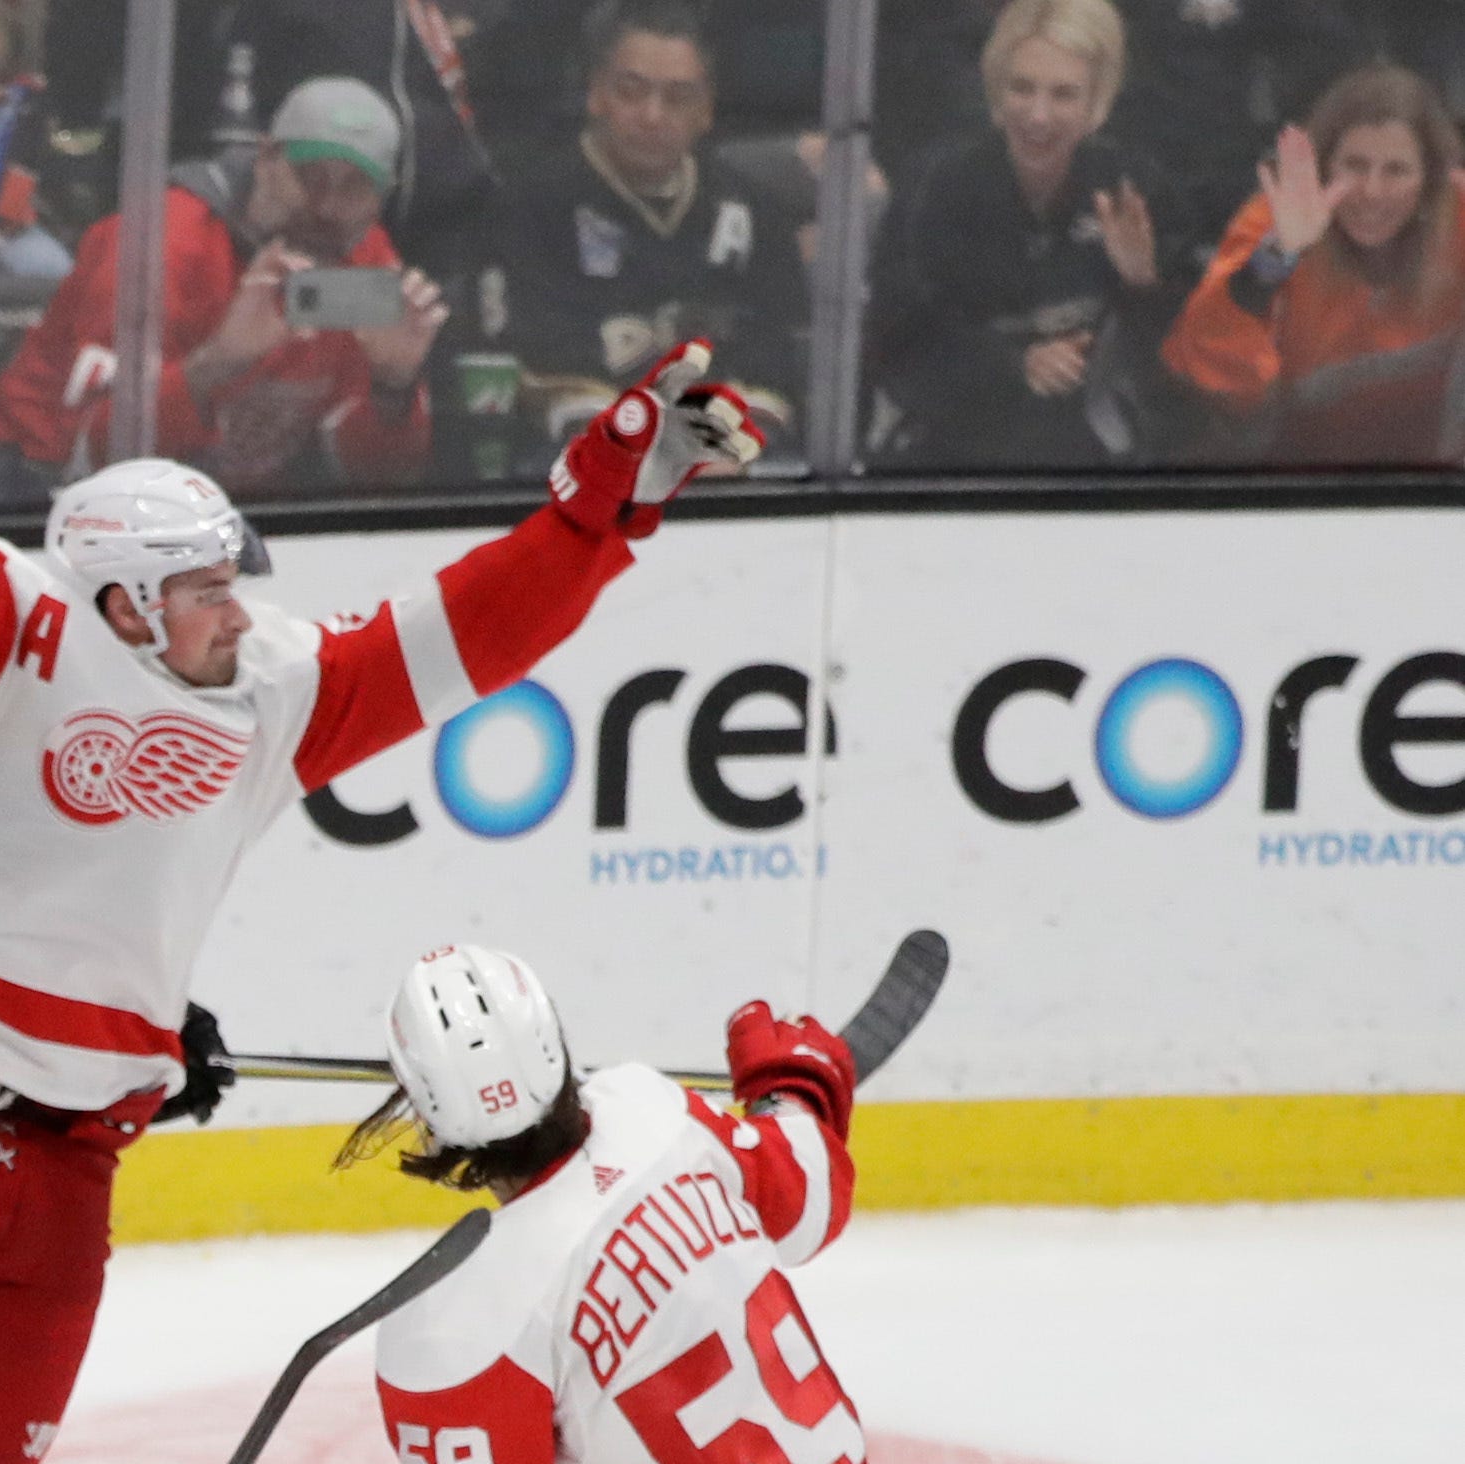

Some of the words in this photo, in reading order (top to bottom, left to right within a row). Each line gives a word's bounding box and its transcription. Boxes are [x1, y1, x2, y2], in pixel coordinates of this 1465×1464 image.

[16, 593, 67, 684] A
[953, 651, 1465, 822] core
[479, 1080, 518, 1114] 59
